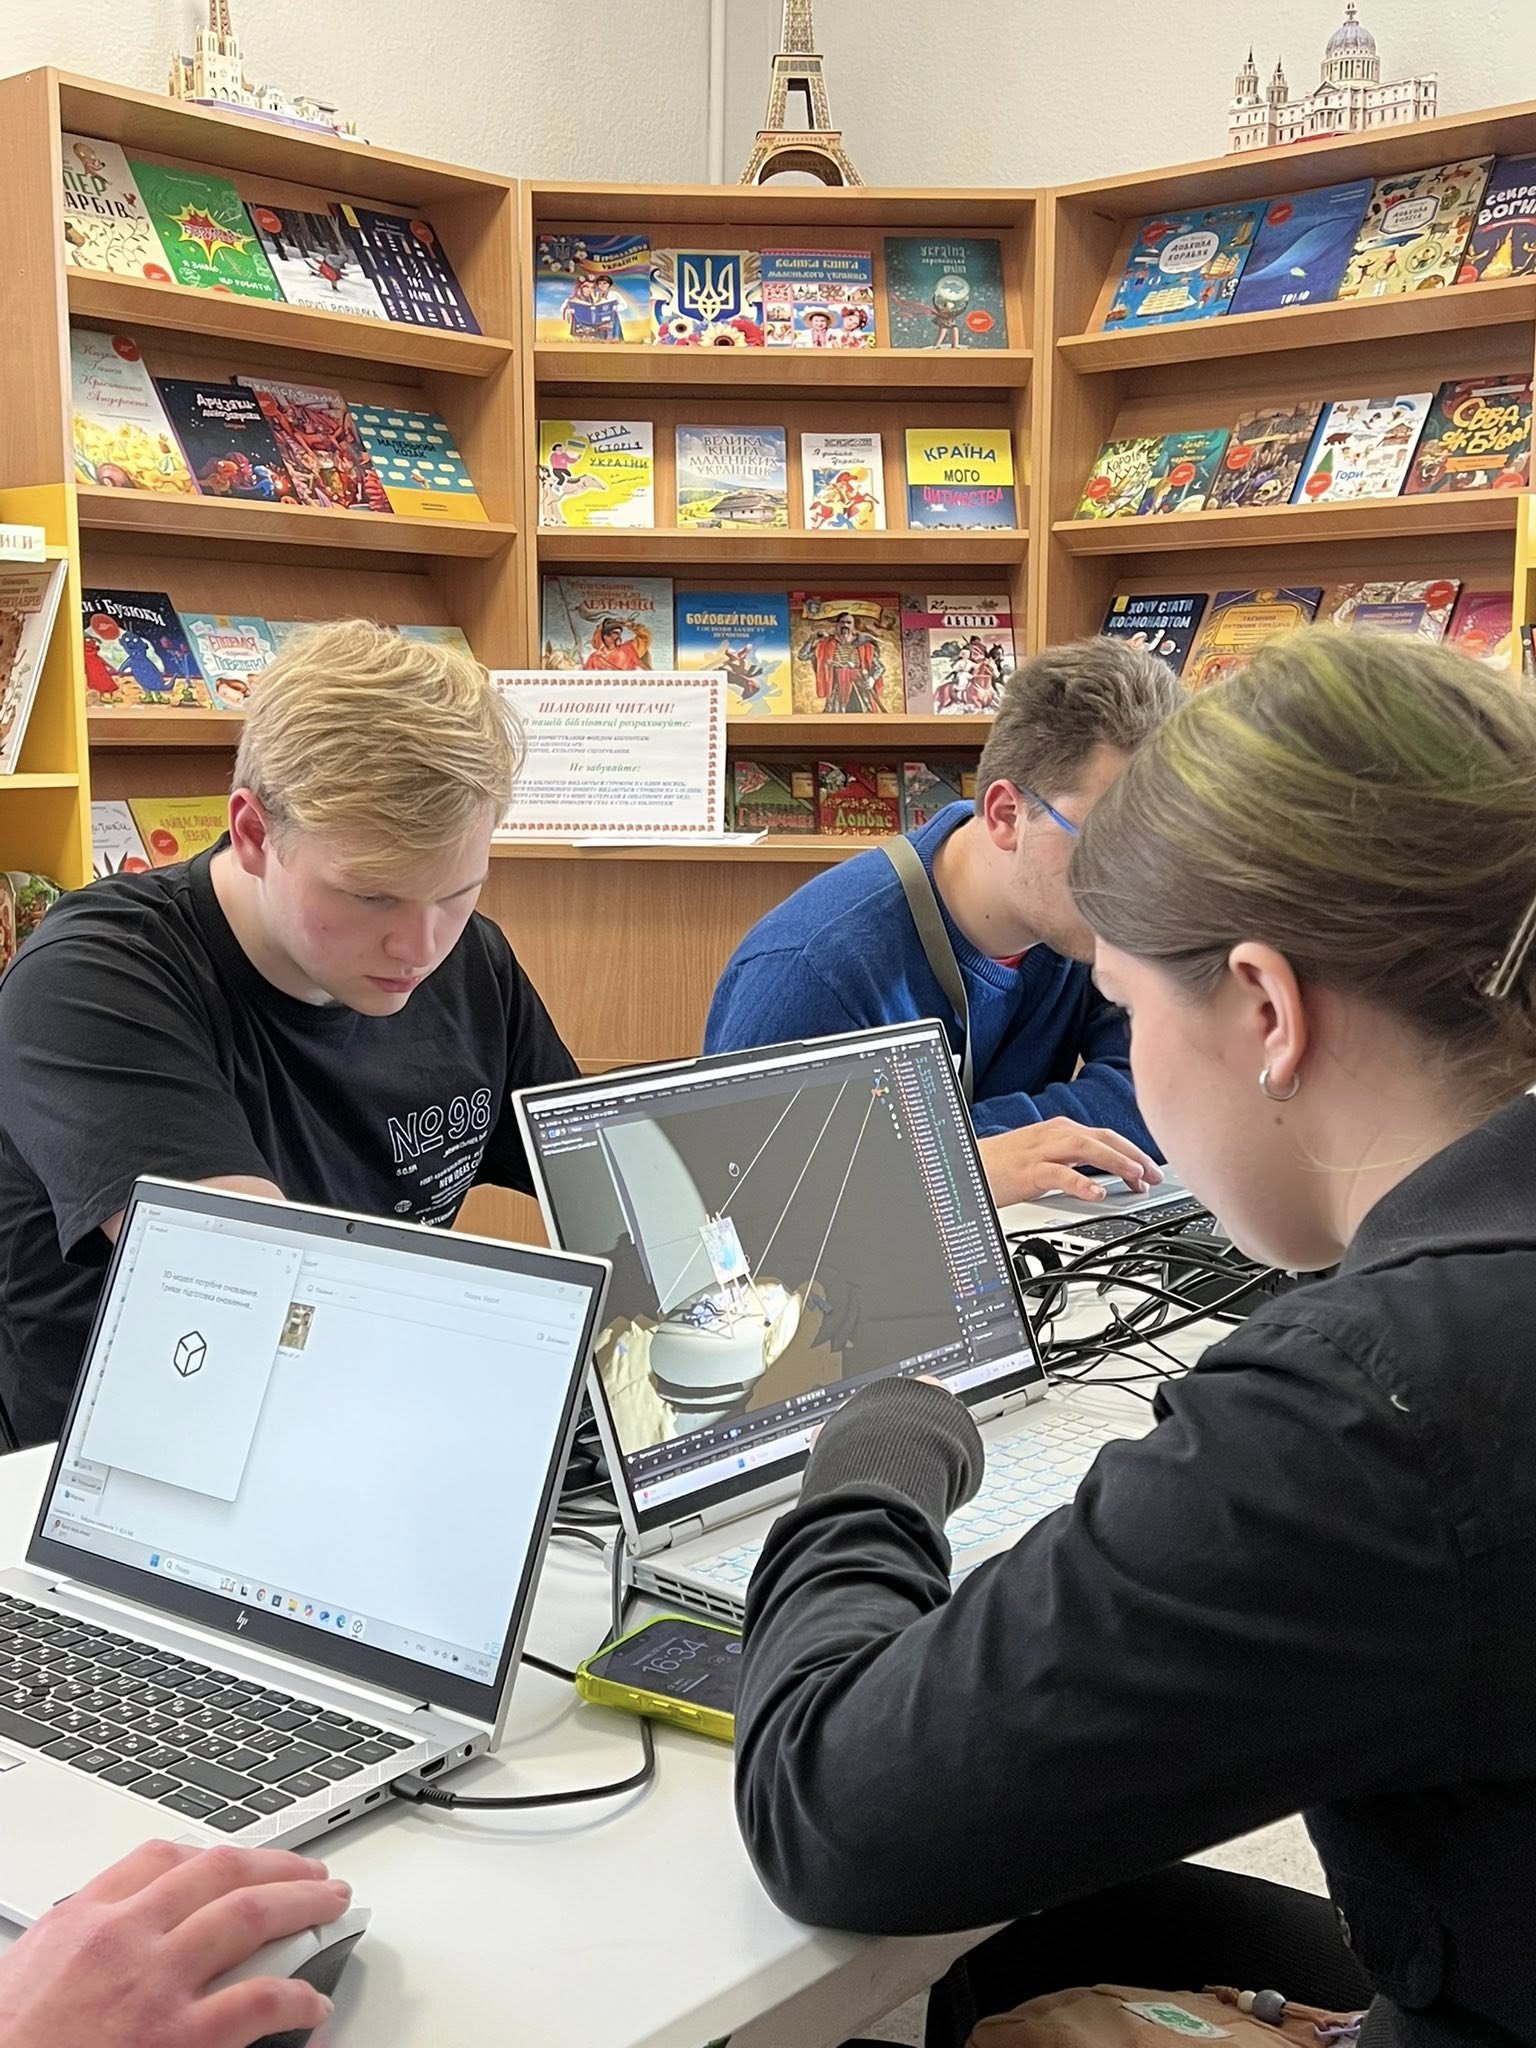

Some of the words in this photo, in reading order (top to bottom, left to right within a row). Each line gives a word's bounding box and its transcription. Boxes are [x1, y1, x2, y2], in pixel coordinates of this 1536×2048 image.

[63, 169, 107, 197] ПЕР
[63, 191, 129, 219] АРБІВ
[703, 436, 763, 447] ВЕЛИКА
[708, 446, 759, 455] КНИГА
[923, 442, 997, 463] КРАЇНА
[690, 455, 778, 468] МАЛЕНЬКИХ
[943, 469, 980, 483] МОГО
[1335, 470, 1364, 483] Гори
[0, 534, 33, 550] ИГИ
[1128, 600, 1159, 615] ХОЧУ
[1158, 599, 1194, 614] СТАТИ
[686, 611, 739, 626] БОЙОВИЙ
[740, 614, 779, 626] ГОПАК
[946, 615, 996, 627] АБЕТКА
[1109, 616, 1192, 628] КОСМОНАВТОМ
[538, 702, 611, 714] ШАНОВНІ
[615, 702, 676, 714] ЧИТАЧІ!
[531, 717, 562, 727] нашій
[564, 717, 616, 728] бібліотеці
[617, 718, 690, 729] розраховуйте:
[569, 763, 583, 772] Не
[586, 763, 641, 774] забувайте:
[835, 808, 893, 828] Донбас
[642, 1638, 709, 1675] 16:34
